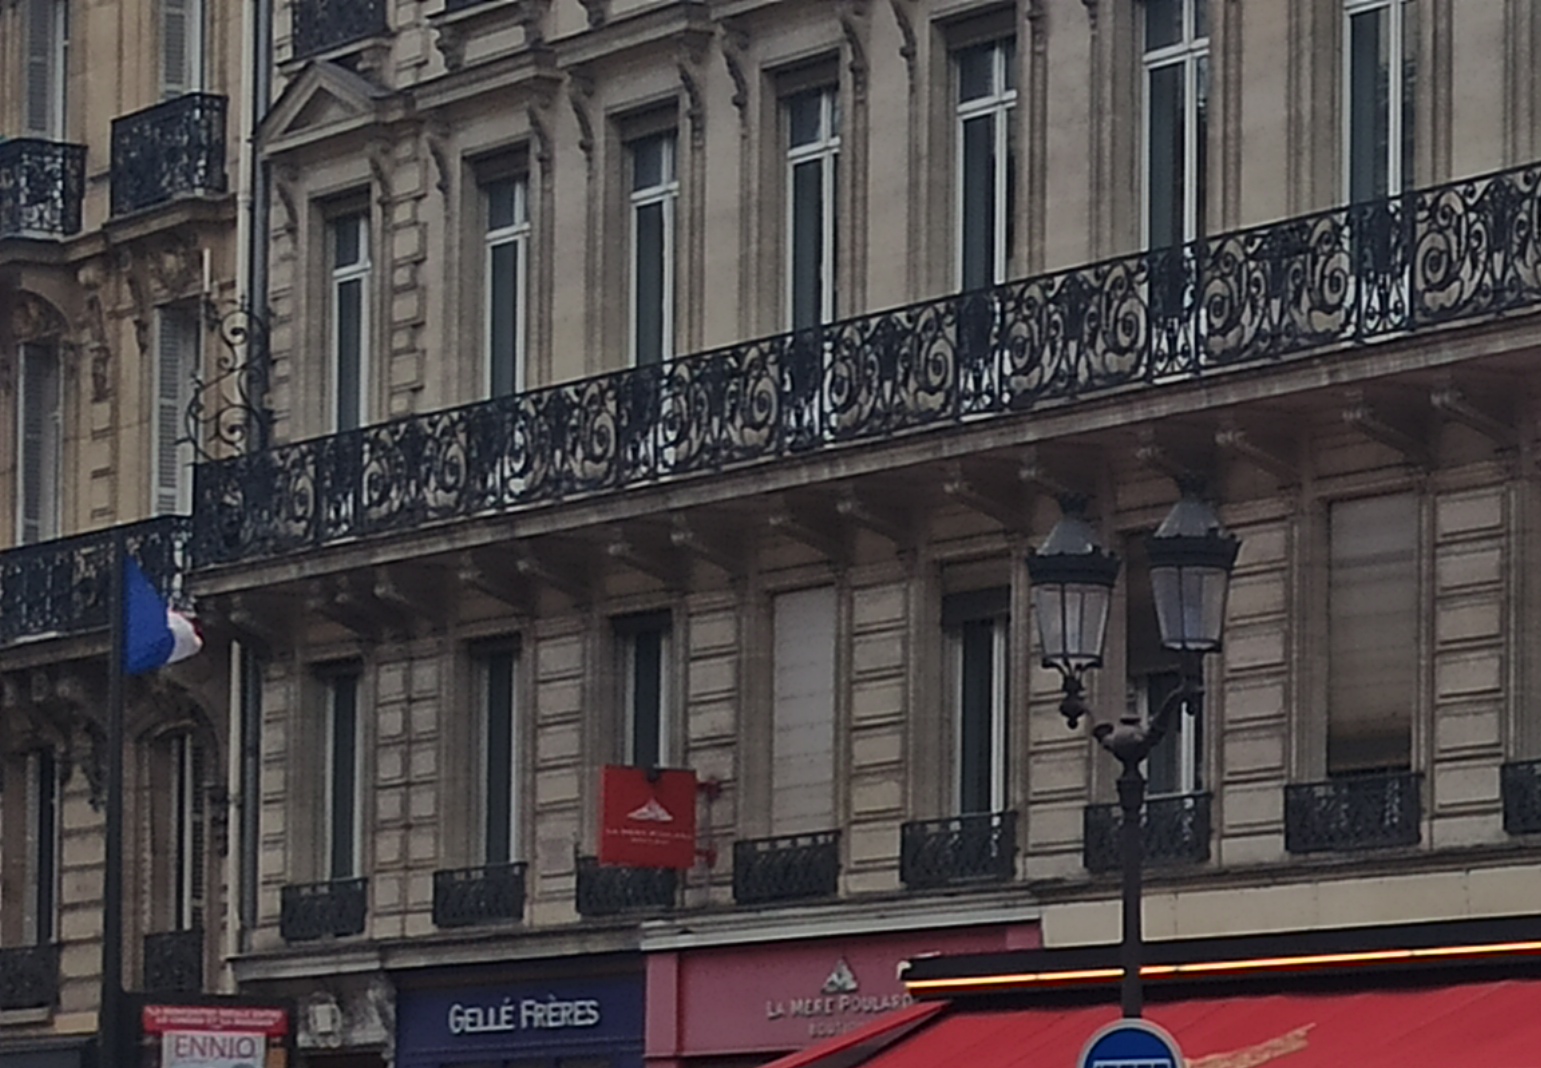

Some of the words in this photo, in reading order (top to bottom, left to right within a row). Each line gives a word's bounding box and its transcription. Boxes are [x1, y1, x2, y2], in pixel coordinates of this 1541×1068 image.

[449, 997, 515, 1033] GELLÉ
[520, 994, 600, 1028] FRÈRES
[767, 1002, 785, 1018] LA
[175, 1035, 256, 1058] ENNIO
